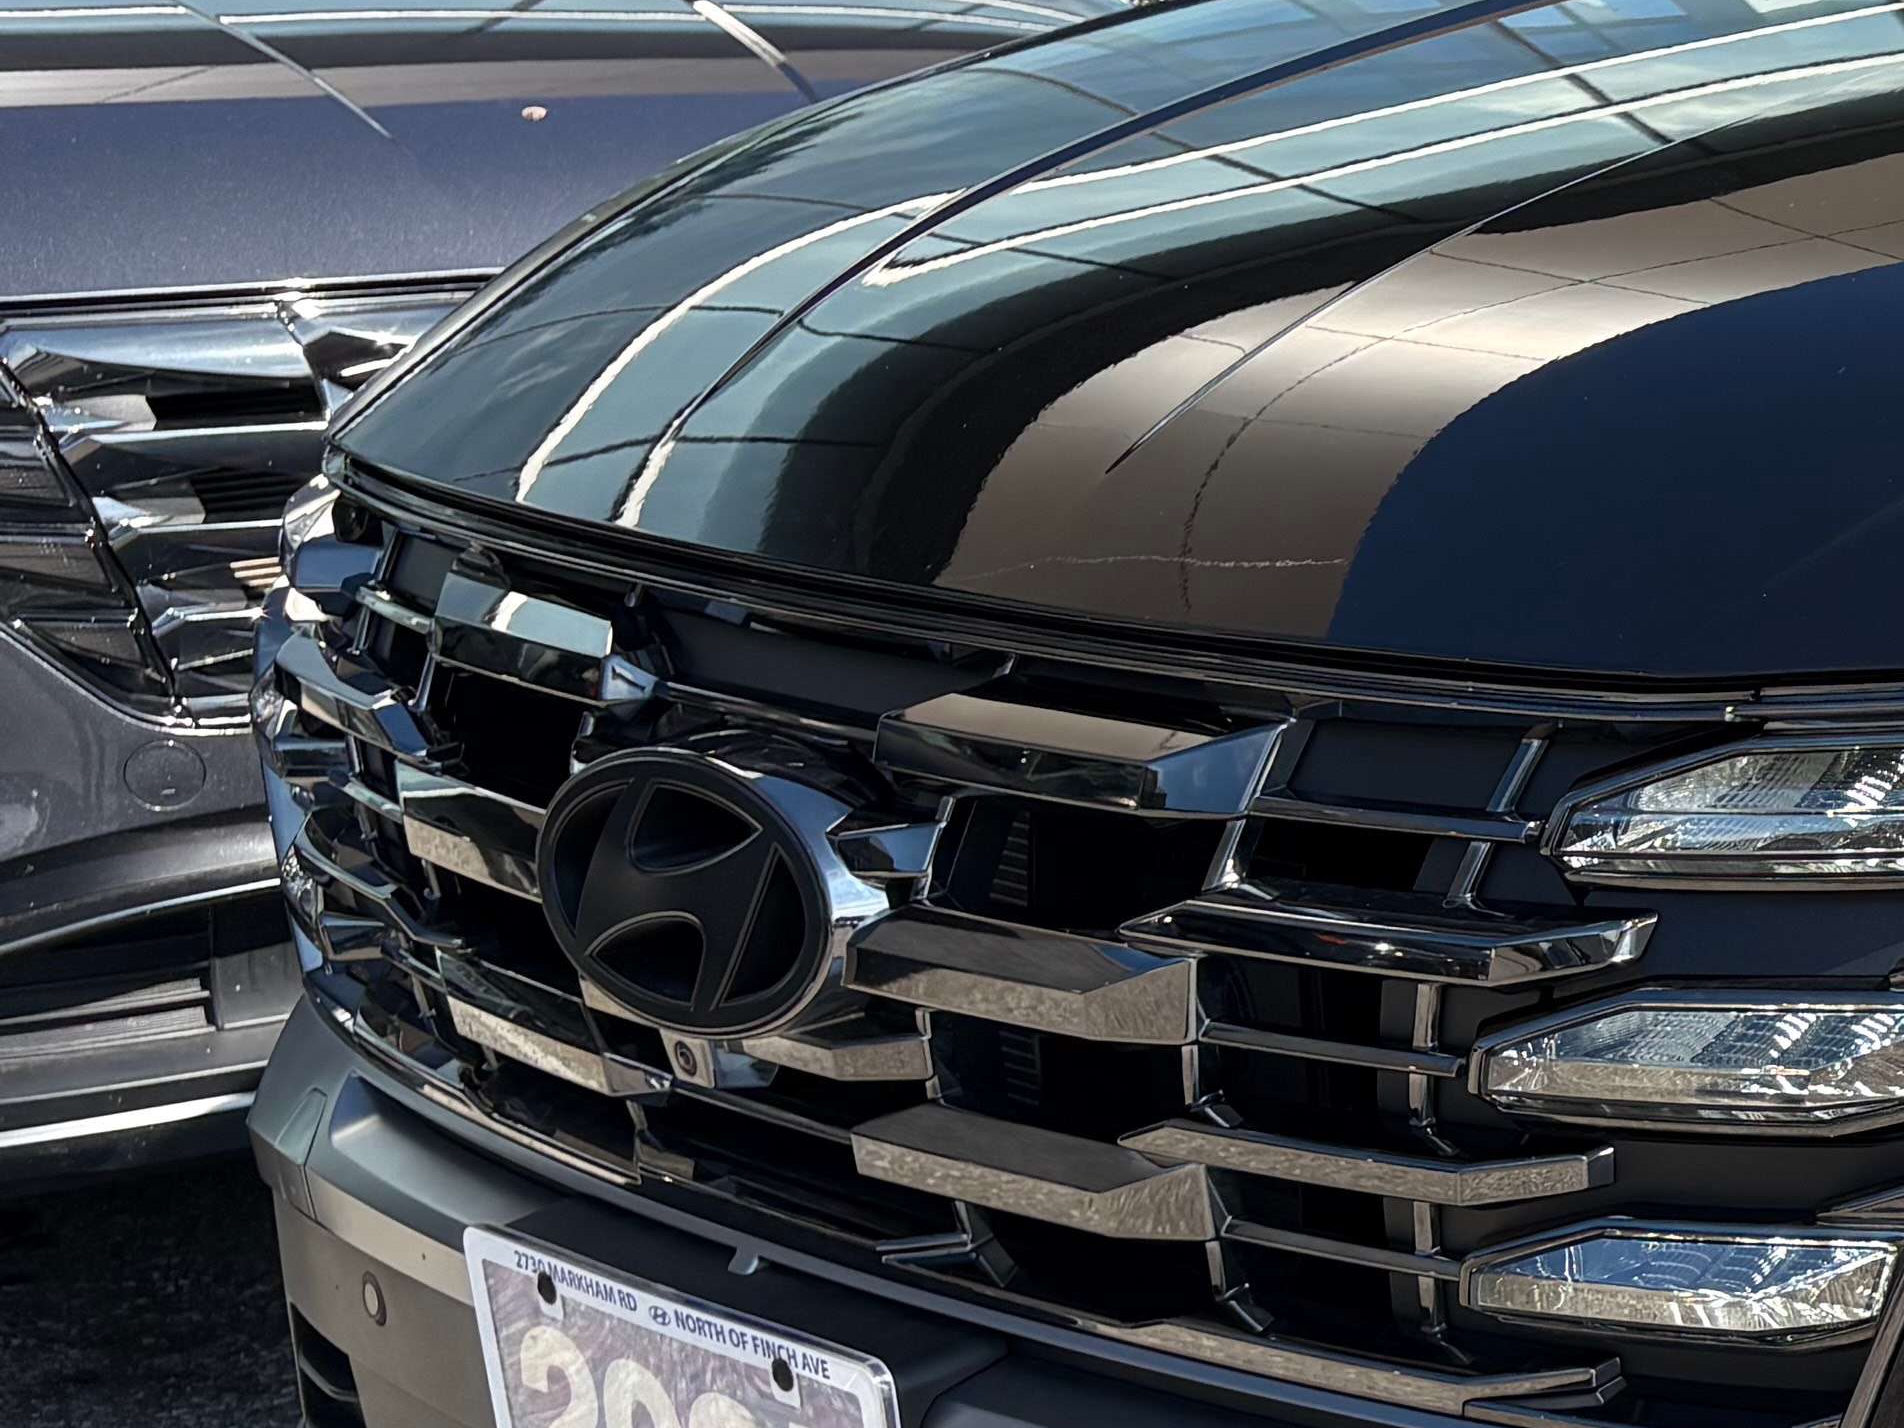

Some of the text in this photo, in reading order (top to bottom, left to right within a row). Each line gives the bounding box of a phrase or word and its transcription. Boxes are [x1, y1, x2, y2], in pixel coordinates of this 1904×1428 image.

[514, 1250, 637, 1311] 2730 MARKHAM RD
[674, 1309, 831, 1380] NORTH OF FINCH AVE
